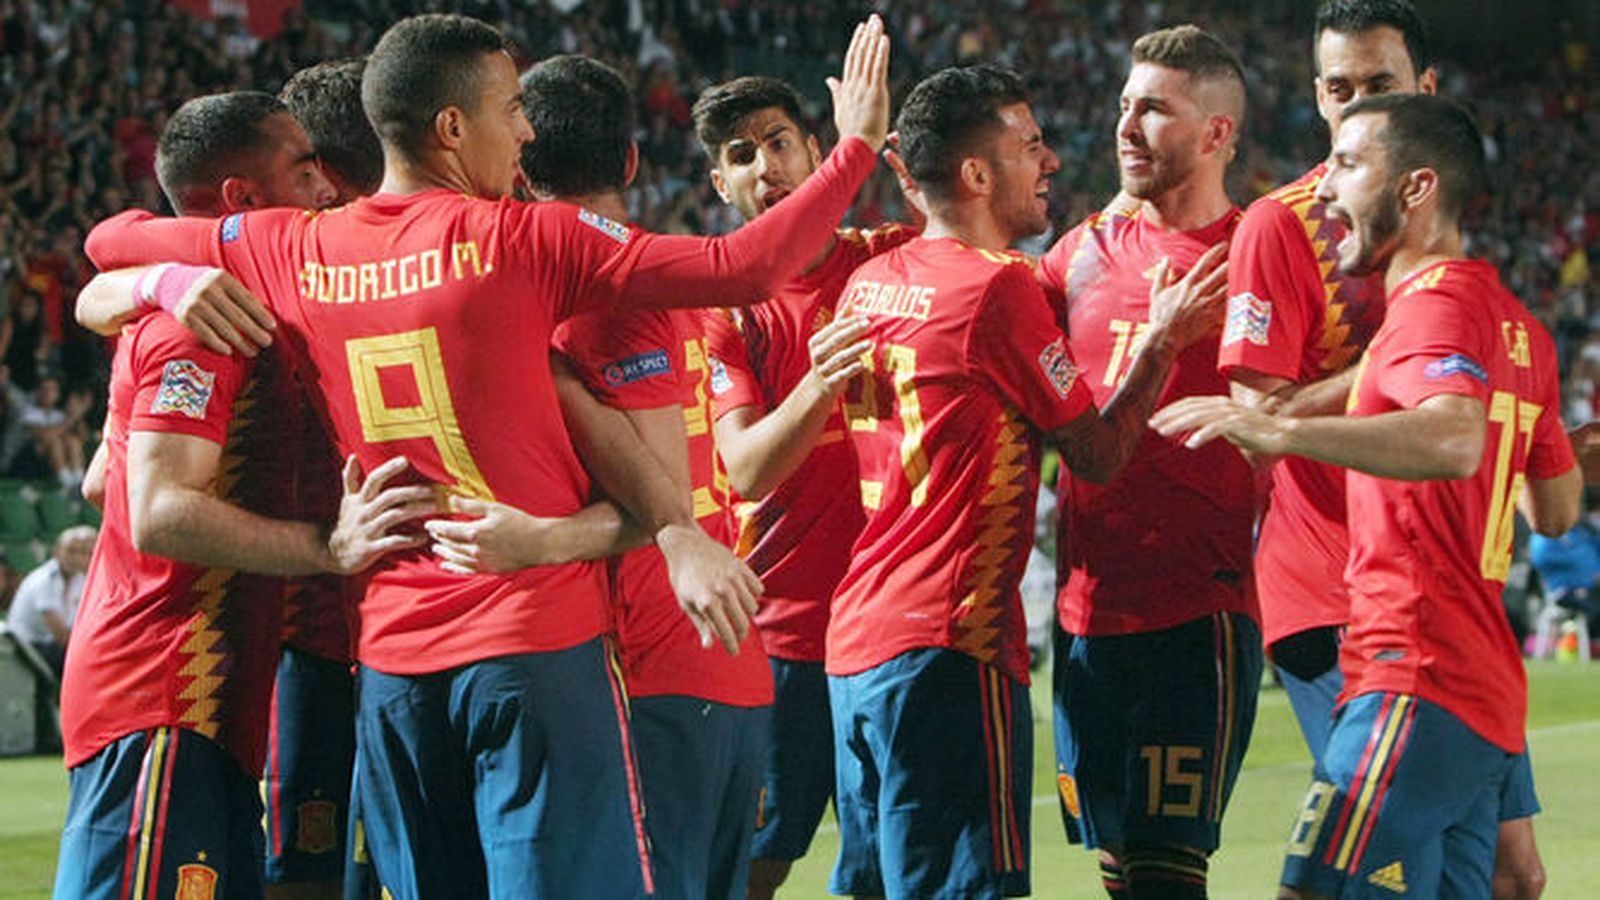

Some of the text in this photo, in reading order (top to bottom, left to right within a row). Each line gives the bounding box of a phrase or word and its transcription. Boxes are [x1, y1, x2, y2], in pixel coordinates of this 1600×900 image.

[452, 240, 493, 281] M.
[345, 326, 497, 514] 9
[1141, 746, 1203, 817] 15
[1286, 781, 1338, 857] 8
